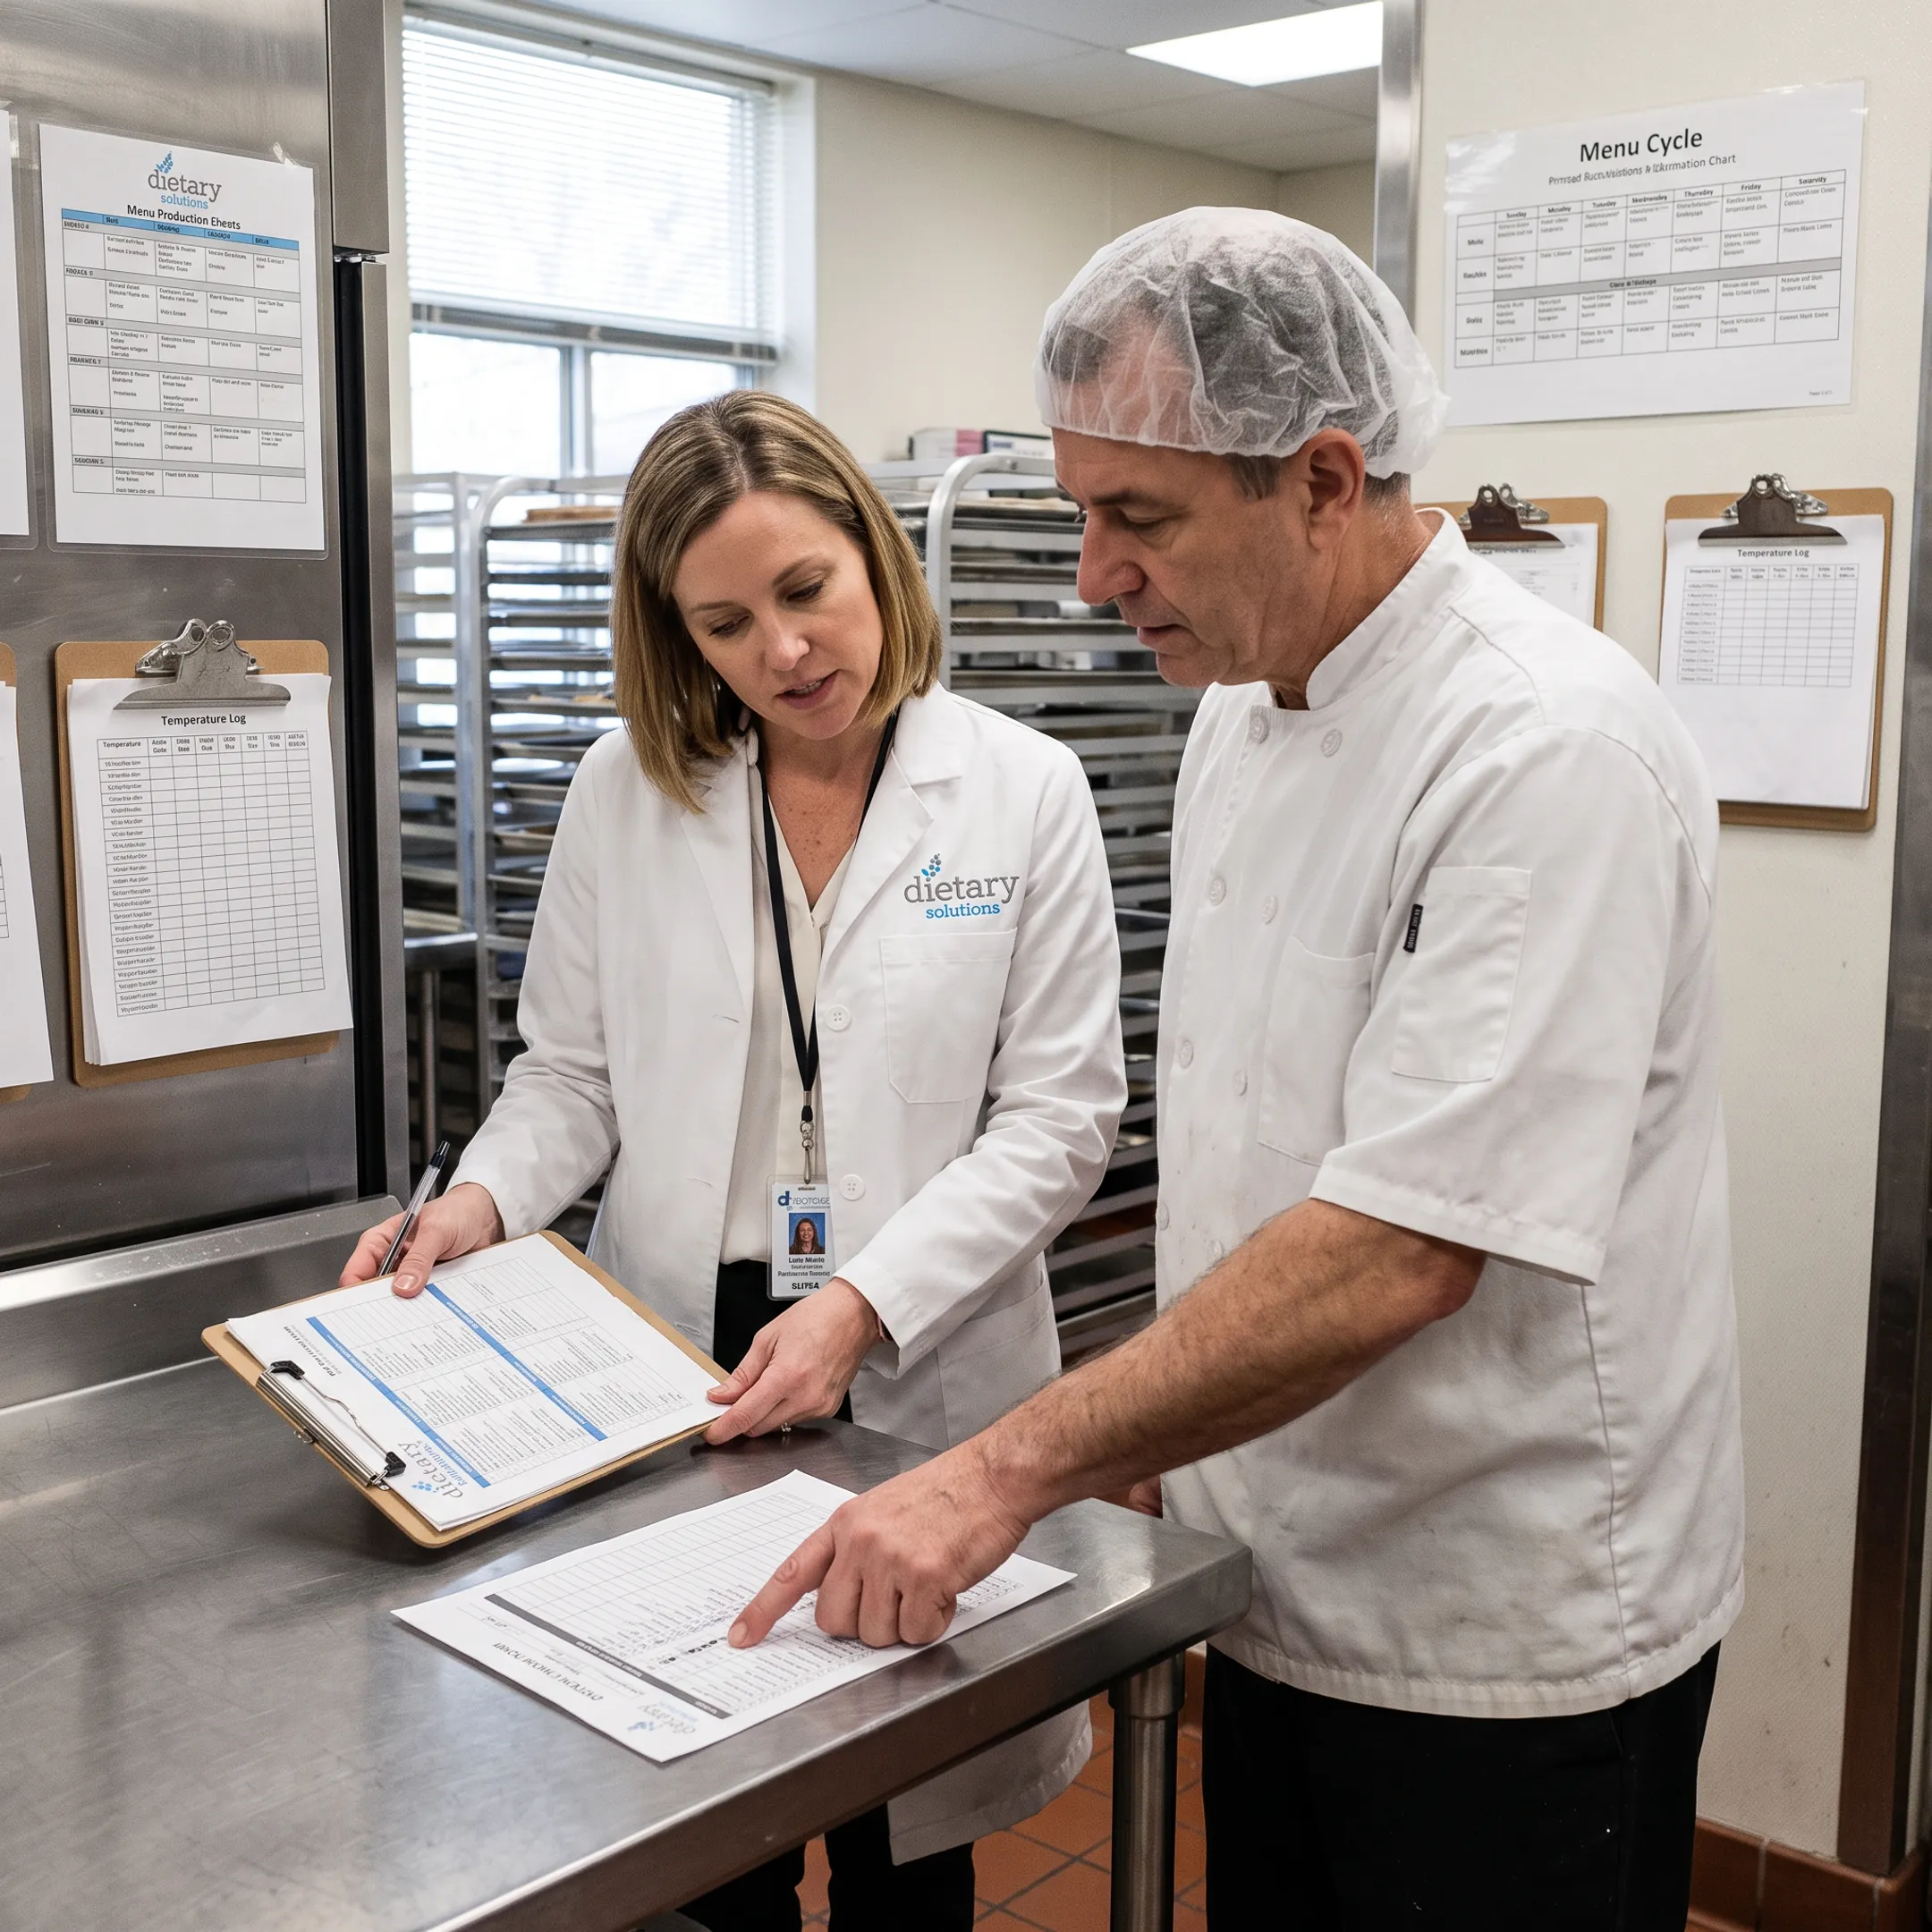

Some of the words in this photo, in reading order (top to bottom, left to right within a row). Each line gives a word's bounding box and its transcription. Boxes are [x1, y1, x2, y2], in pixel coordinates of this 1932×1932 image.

[1580, 140, 1640, 163] Menu
[1647, 128, 1703, 157] Cycle
[1708, 154, 1737, 166] Chart
[148, 168, 222, 203] dietary
[1741, 183, 1762, 192] Friday
[160, 193, 208, 209] solutions
[127, 204, 156, 218] Menu
[157, 208, 208, 225] Production
[1737, 549, 1792, 559] Temperature
[1795, 548, 1809, 558] Log
[161, 714, 227, 727] Temperature
[229, 713, 247, 724] Log
[103, 741, 142, 750] Temperature
[903, 876, 1020, 904] dietary
[926, 902, 1001, 919] solutions
